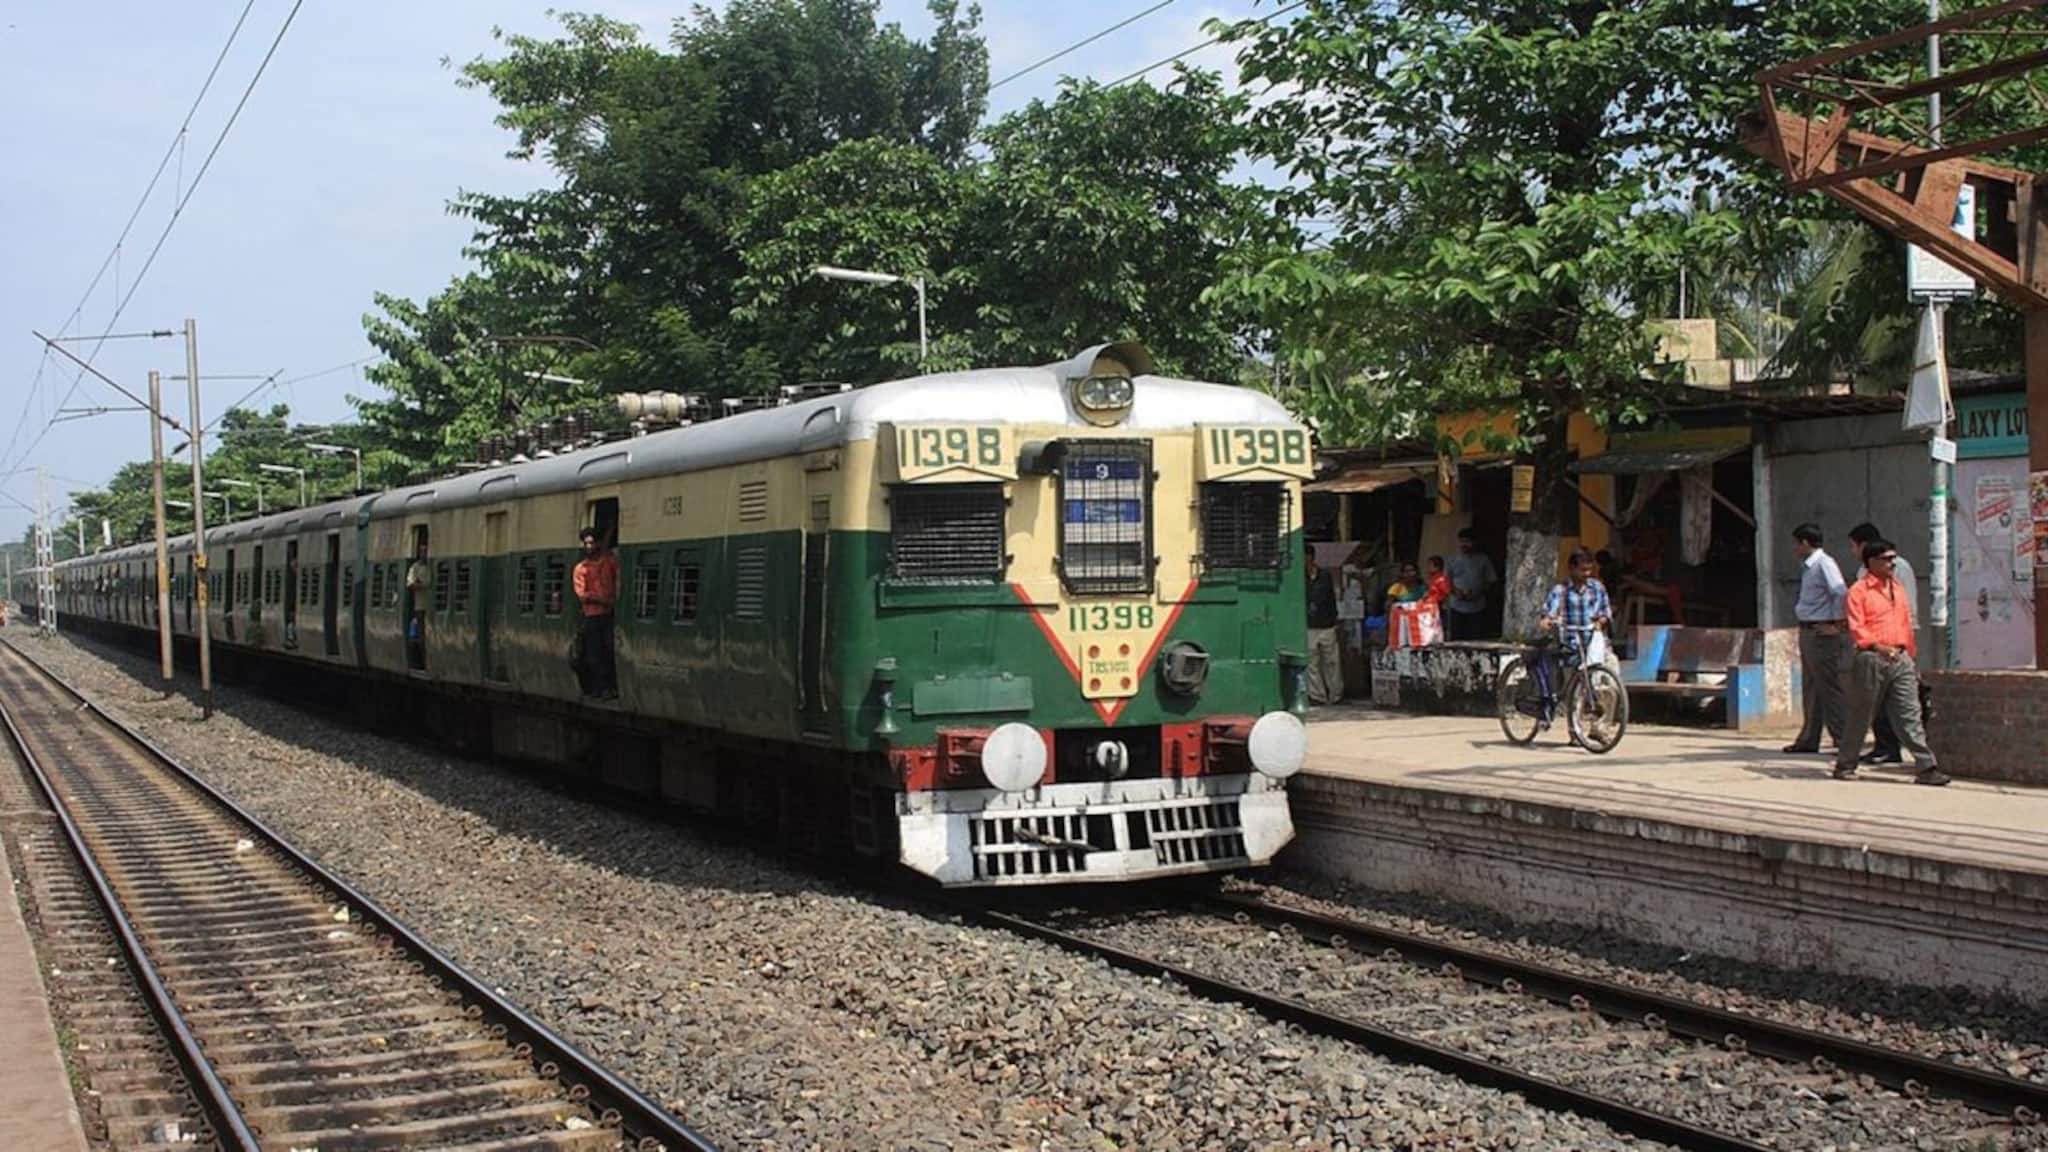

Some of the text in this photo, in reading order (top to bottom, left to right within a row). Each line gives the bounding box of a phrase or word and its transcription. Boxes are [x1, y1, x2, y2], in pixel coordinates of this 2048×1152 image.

[1957, 408, 2001, 439] LAXY
[900, 427, 1001, 468] 11398
[1211, 428, 1305, 467] 11398
[1095, 462, 1110, 480] 9
[1069, 605, 1154, 633] 11398
